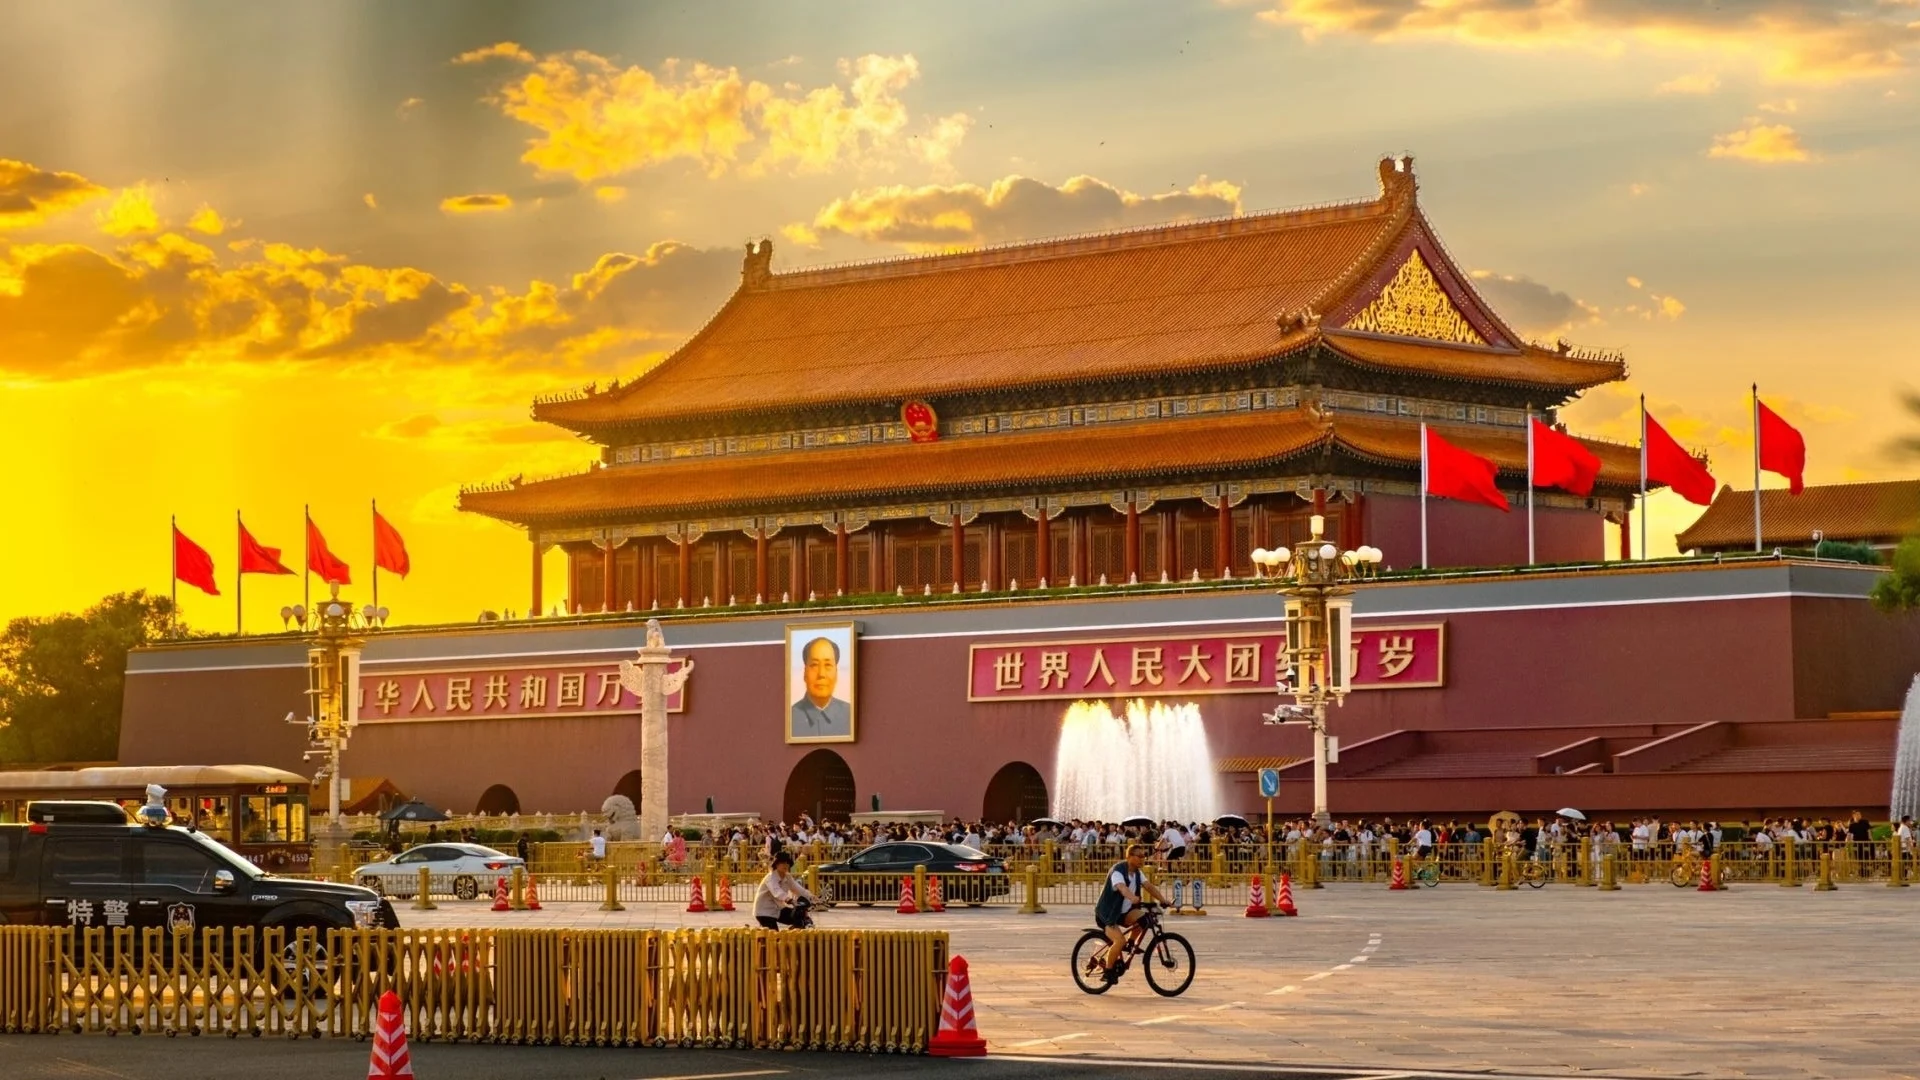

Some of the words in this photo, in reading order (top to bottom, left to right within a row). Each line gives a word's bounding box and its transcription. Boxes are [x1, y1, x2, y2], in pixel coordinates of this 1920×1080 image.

[358, 672, 643, 714] 华人民共和国万
[67, 899, 129, 926] 特警
